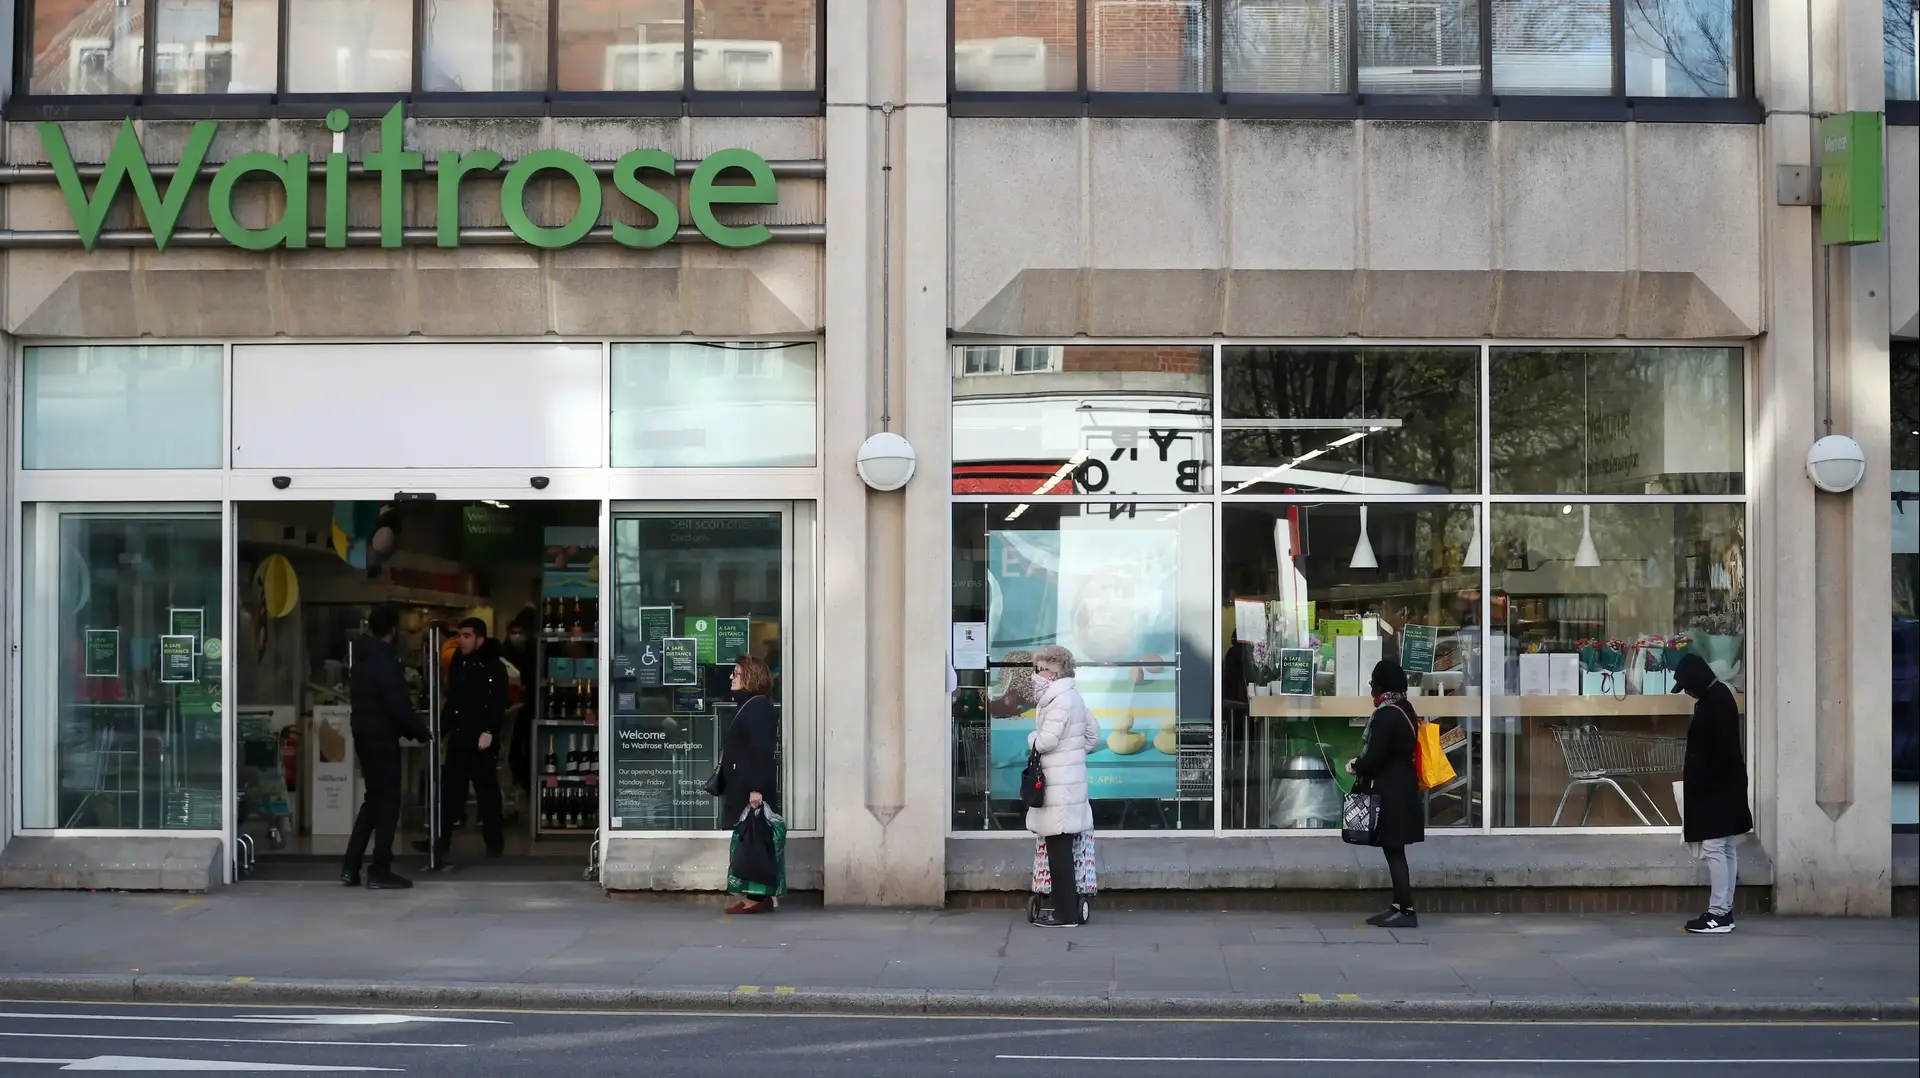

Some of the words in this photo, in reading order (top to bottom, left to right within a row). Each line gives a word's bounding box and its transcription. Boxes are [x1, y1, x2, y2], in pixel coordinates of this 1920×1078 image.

[37, 101, 778, 252] Waitrose
[618, 729, 667, 740] Welcome
[663, 742, 703, 751] Kensington
[1097, 775, 1123, 784] APRIL
